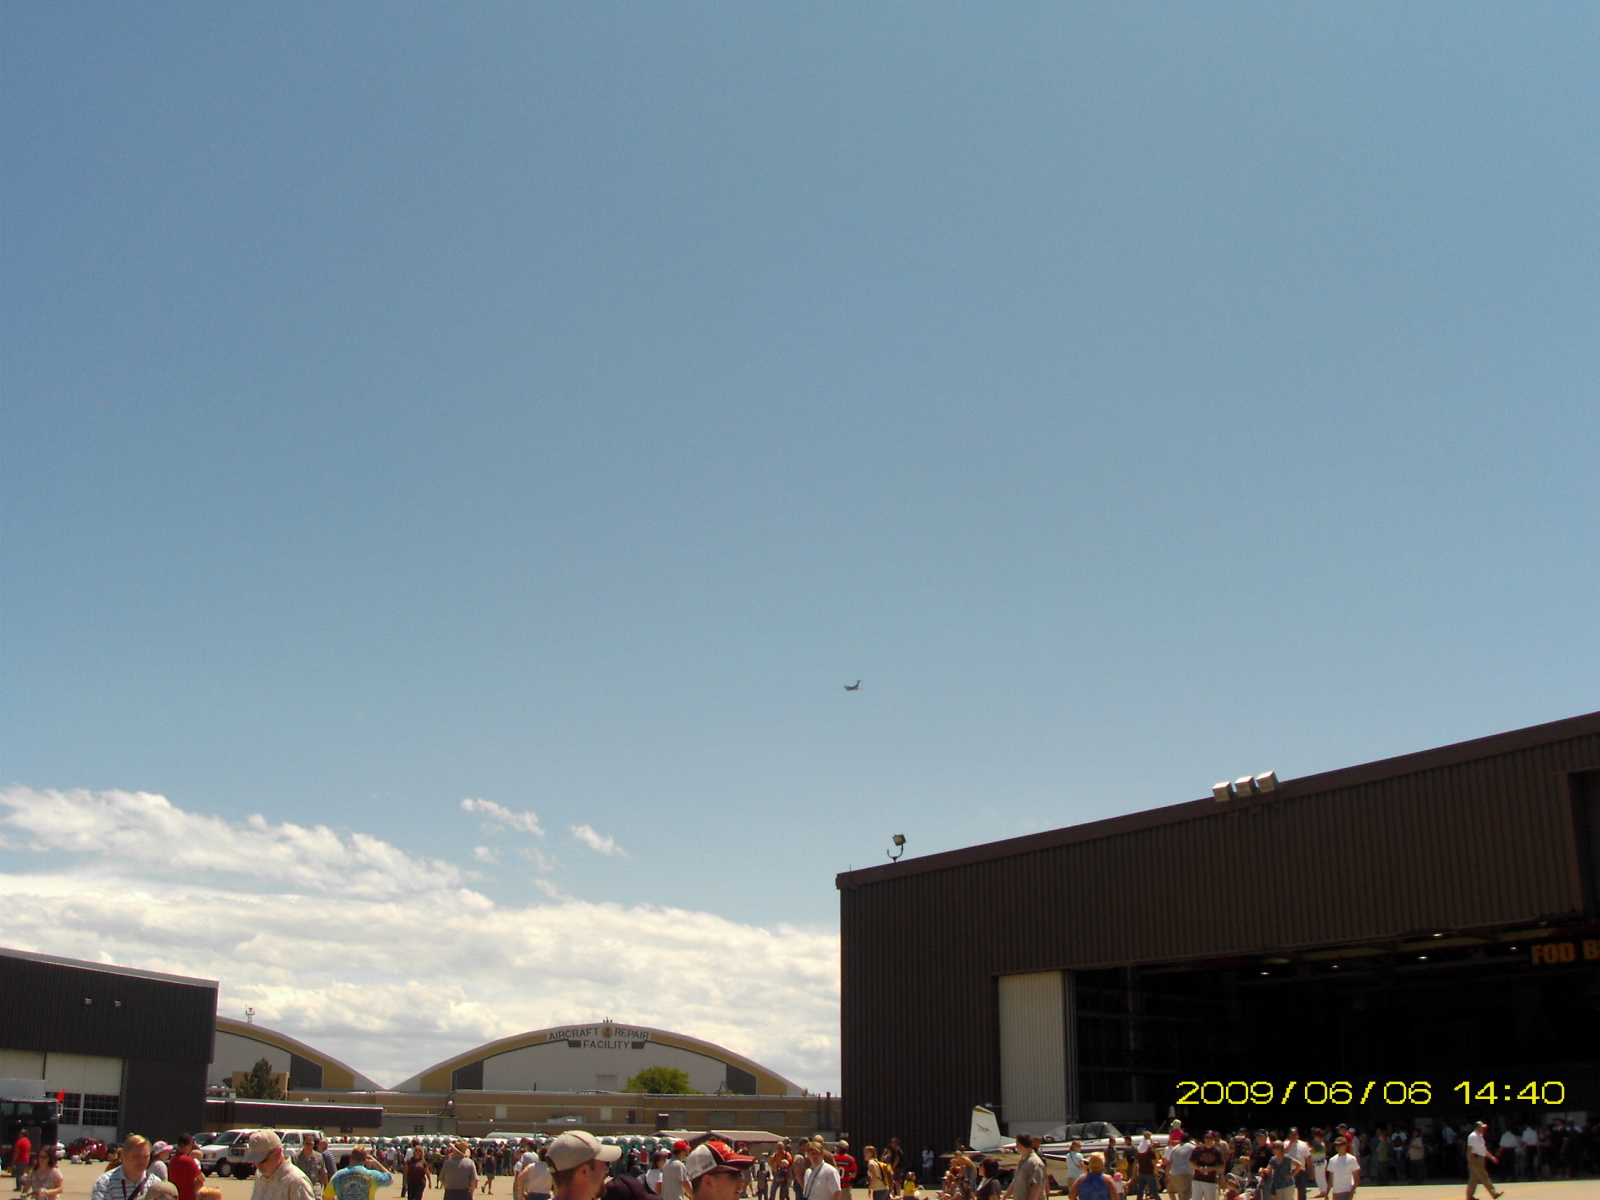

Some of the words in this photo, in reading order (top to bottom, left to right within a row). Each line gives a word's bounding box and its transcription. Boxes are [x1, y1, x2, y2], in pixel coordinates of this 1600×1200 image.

[549, 1027, 599, 1040] AIRCRAFT
[615, 1027, 649, 1040] REPAIR
[583, 1040, 630, 1049] FACILITY
